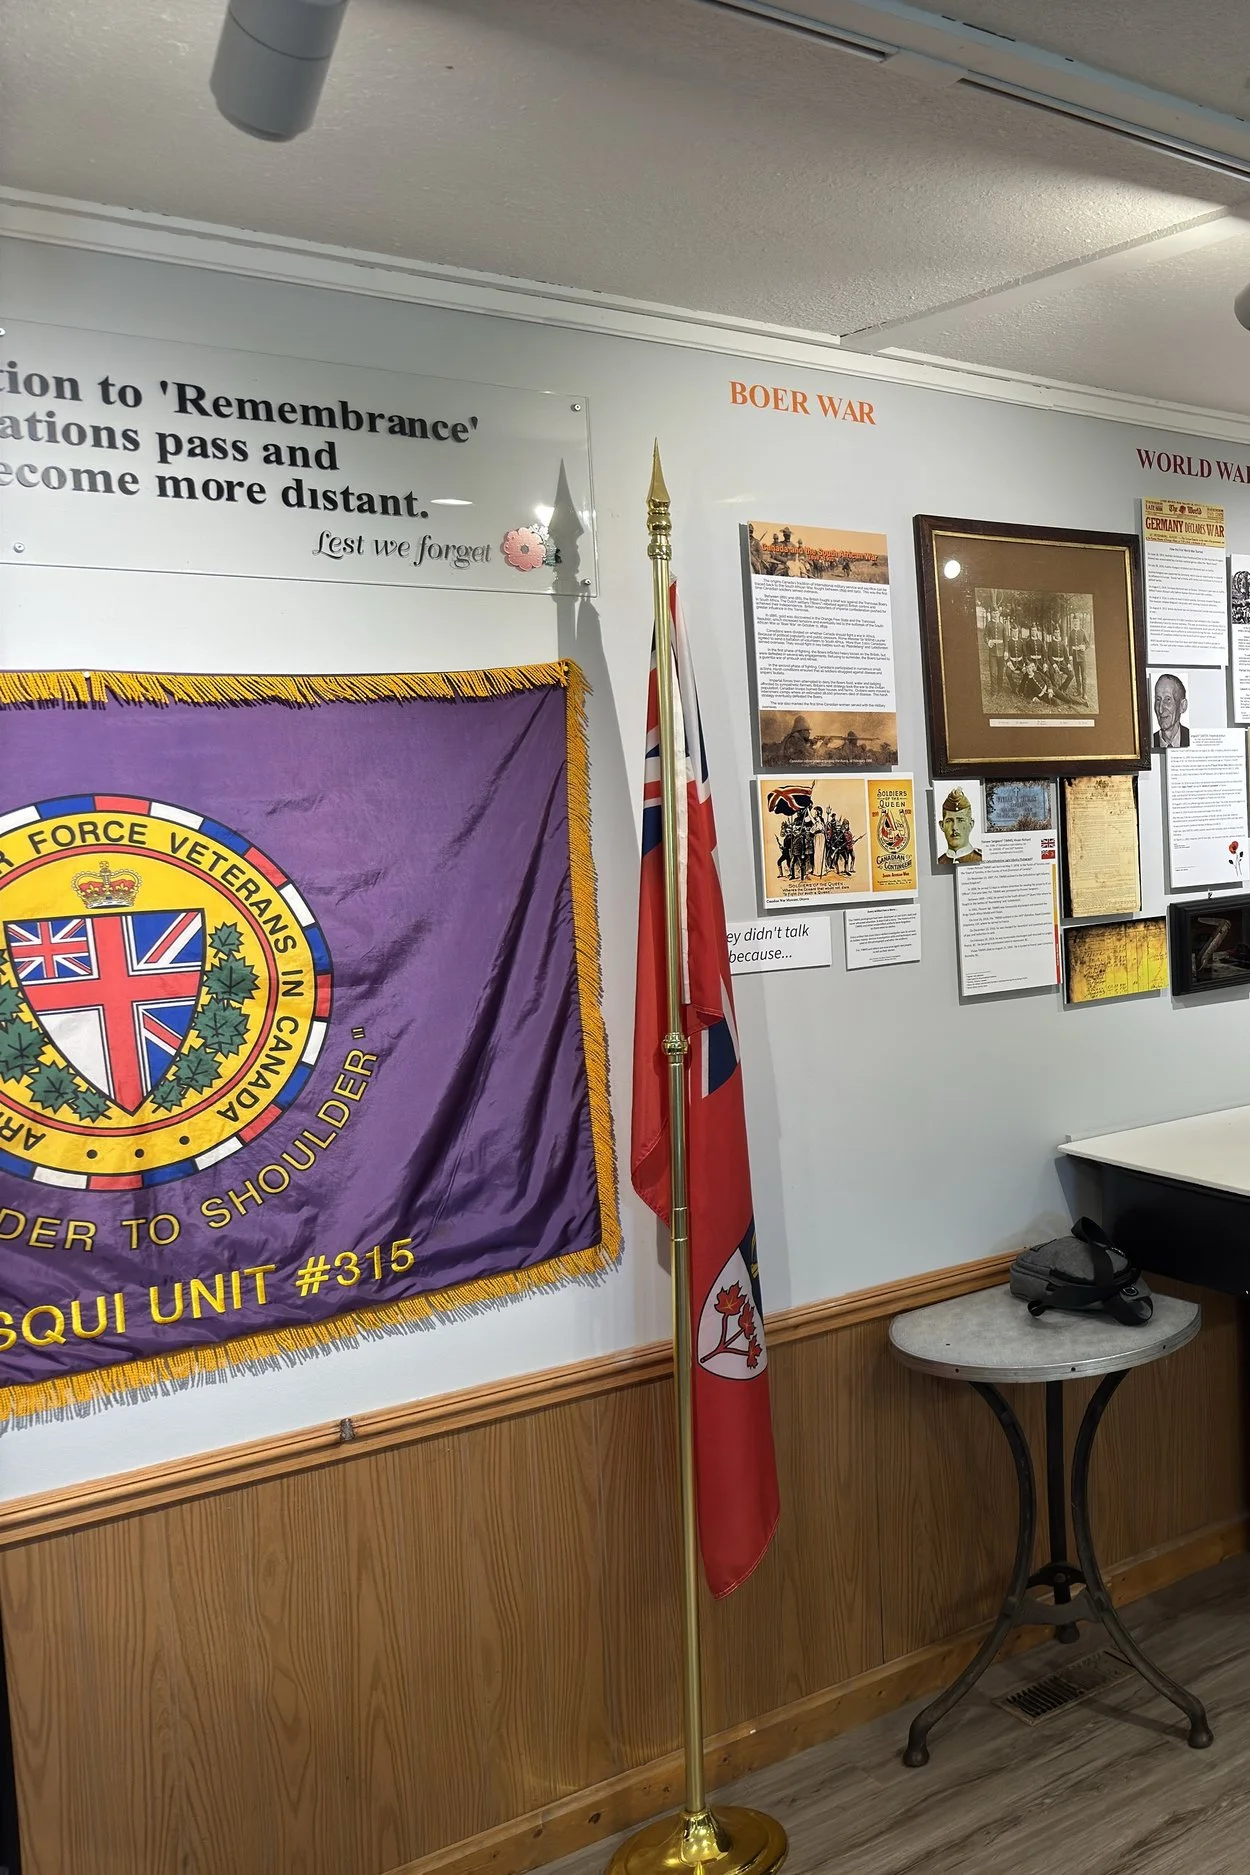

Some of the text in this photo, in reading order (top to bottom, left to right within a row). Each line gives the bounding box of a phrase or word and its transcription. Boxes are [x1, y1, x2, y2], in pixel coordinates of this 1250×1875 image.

[0, 360, 478, 443] ion to 'Remembrance'
[728, 380, 877, 425] BOER WAR
[155, 431, 249, 465] pass
[262, 440, 340, 471] and
[1136, 448, 1212, 478] WORLD
[156, 474, 267, 505] more
[1145, 517, 1184, 533] GERMANY
[1206, 524, 1225, 538] WAR
[312, 529, 492, 569] Lest we forget
[877, 789, 907, 798] SOLDIERS
[878, 800, 906, 809] QUEEN
[876, 854, 905, 865] CANADIAN
[744, 926, 783, 942] didn't
[785, 924, 810, 938] talk
[28, 820, 305, 1123] FORCE VETERANS IN CANADA
[728, 949, 793, 963] because...
[122, 1213, 182, 1250] TO
[149, 1264, 277, 1325] UNIT
[295, 1238, 416, 1297] #315
